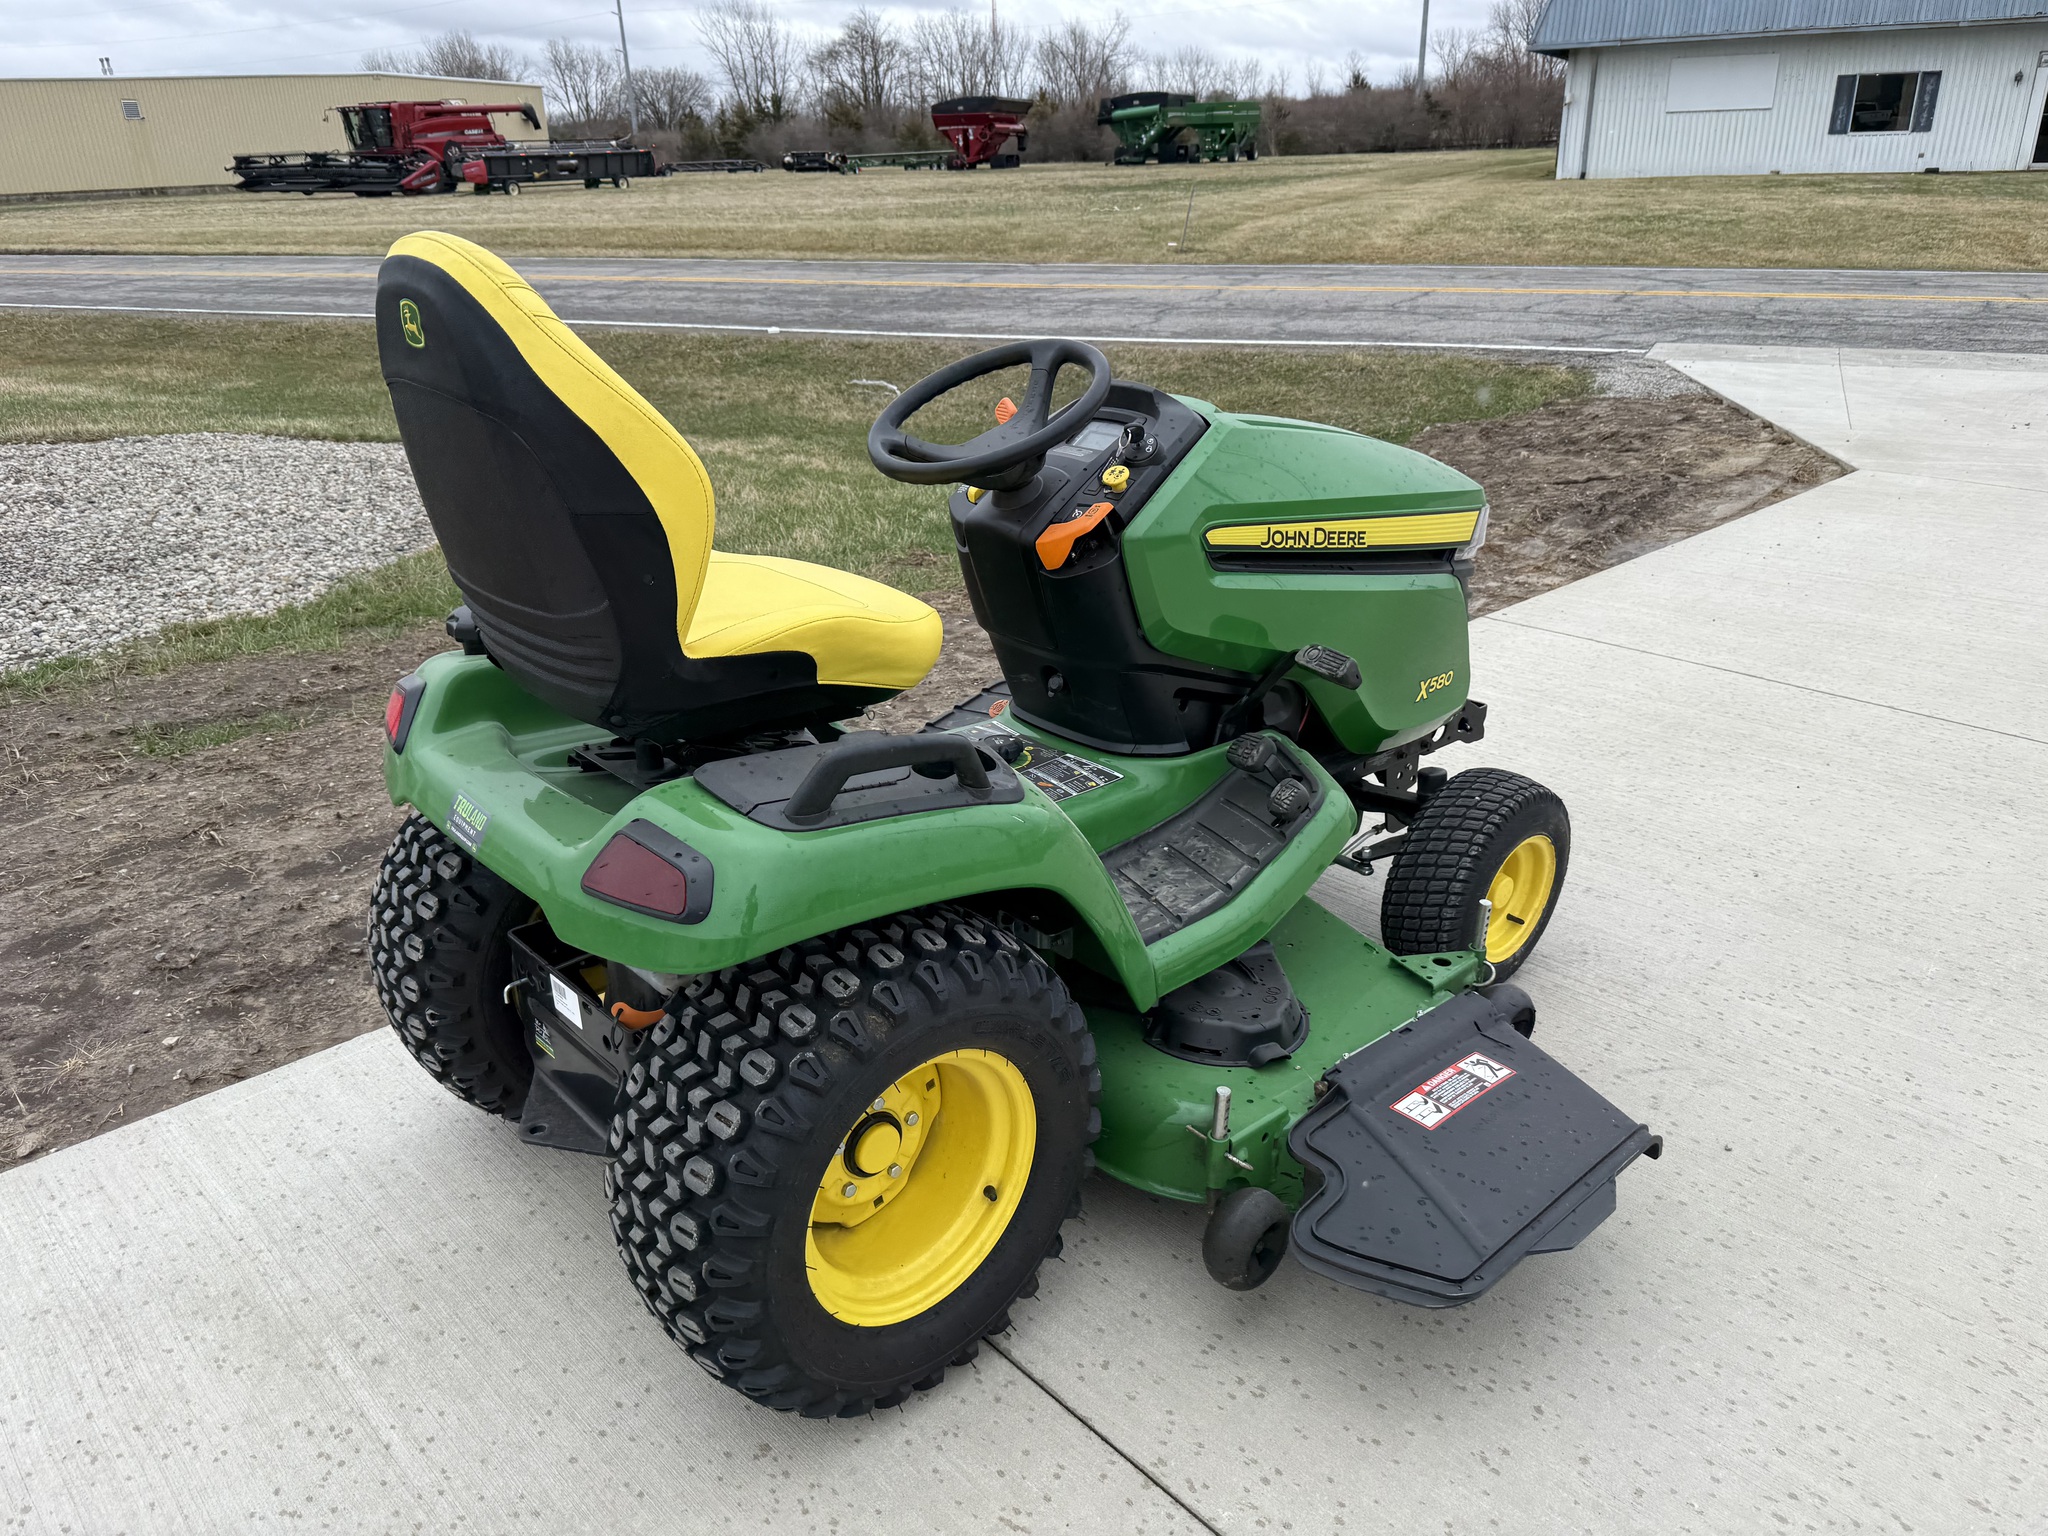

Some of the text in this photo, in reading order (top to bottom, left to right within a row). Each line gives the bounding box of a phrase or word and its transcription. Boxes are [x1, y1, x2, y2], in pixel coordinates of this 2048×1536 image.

[1260, 526, 1367, 547] JOHN DEERE
[1414, 669, 1455, 703] X580
[453, 794, 488, 831] TRULAND
[453, 814, 477, 837] EQUIPMENT
[1427, 1068, 1457, 1087] DANGER
